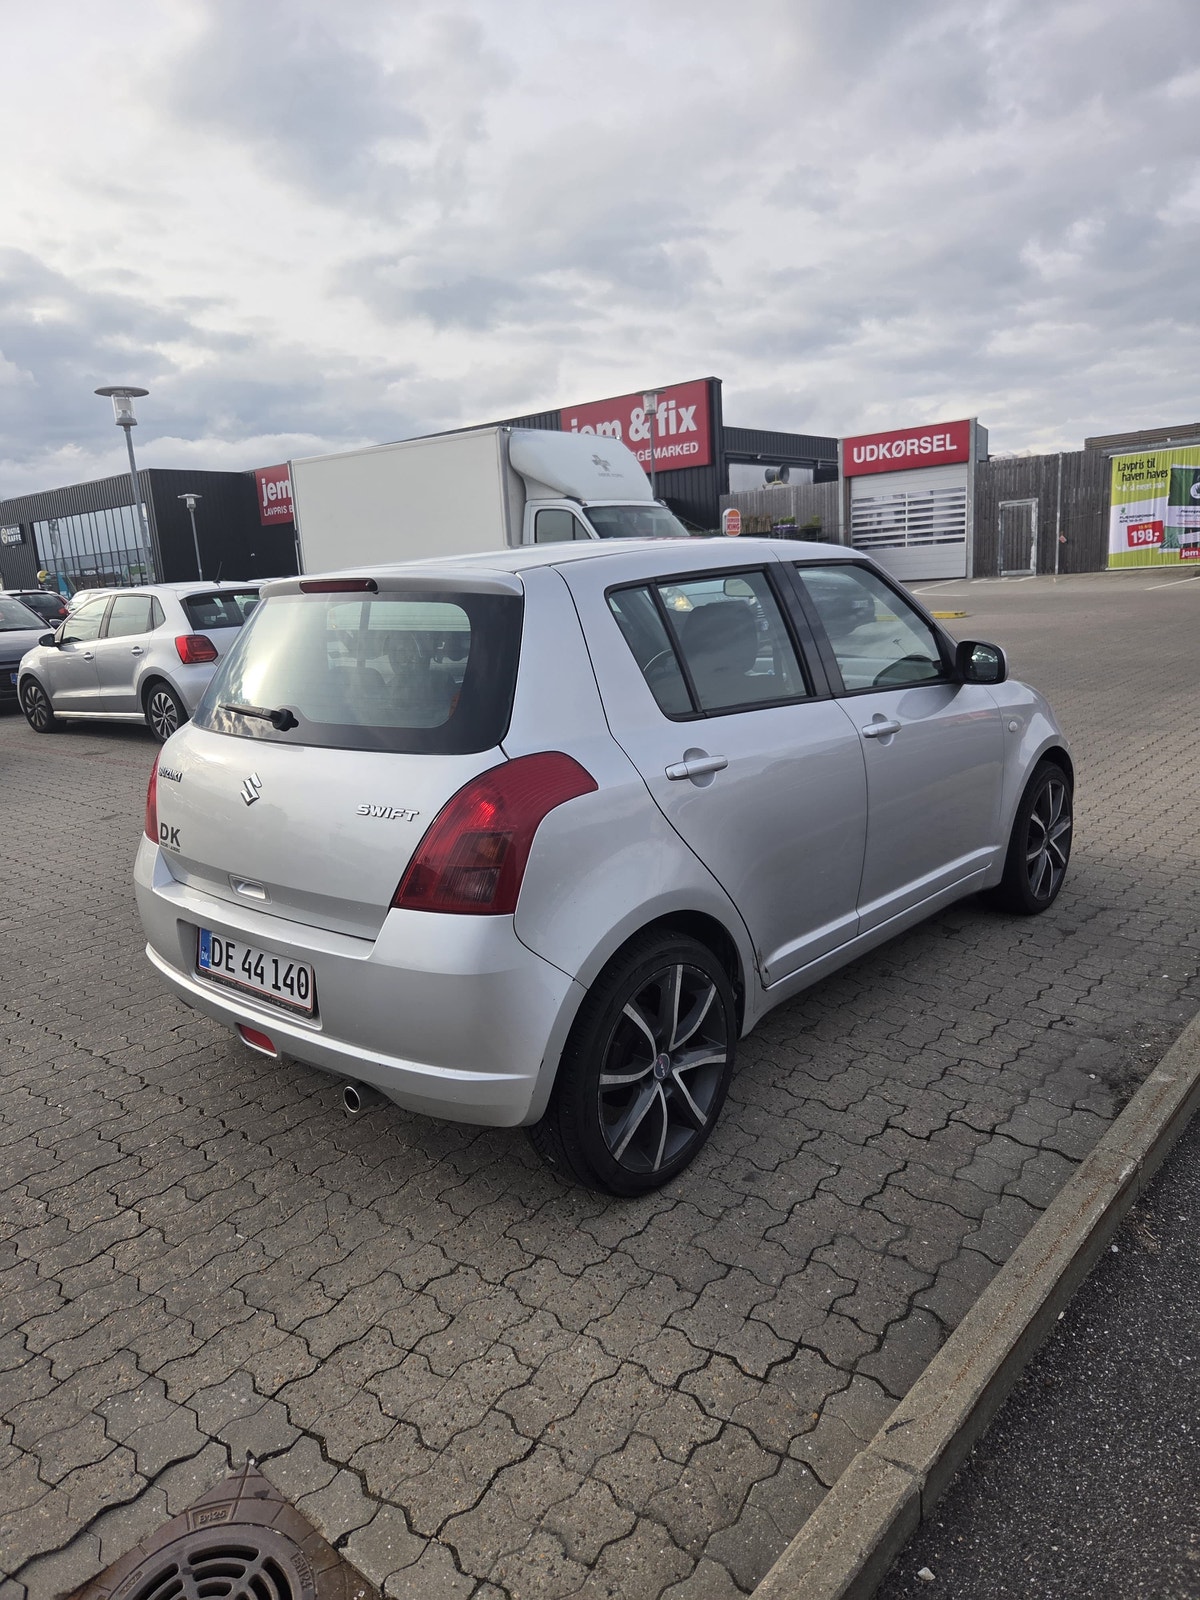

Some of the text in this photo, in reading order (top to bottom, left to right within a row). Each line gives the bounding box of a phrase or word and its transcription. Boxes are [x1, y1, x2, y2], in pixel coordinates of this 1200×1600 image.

[629, 407, 651, 442] &
[656, 400, 698, 437] fix
[631, 442, 699, 462] GEMARKED
[853, 433, 957, 463] UDKØRSEL
[1117, 457, 1156, 472] Lavpris til
[1122, 469, 1168, 482] haven haves
[261, 477, 292, 507] jem
[263, 505, 288, 517] LAVPRIS
[158, 766, 183, 782] SUZUKI
[356, 804, 420, 822] SWIFT
[160, 822, 181, 848] DK
[211, 936, 236, 973] DE
[242, 948, 264, 985] 44
[272, 958, 309, 1000] 140
